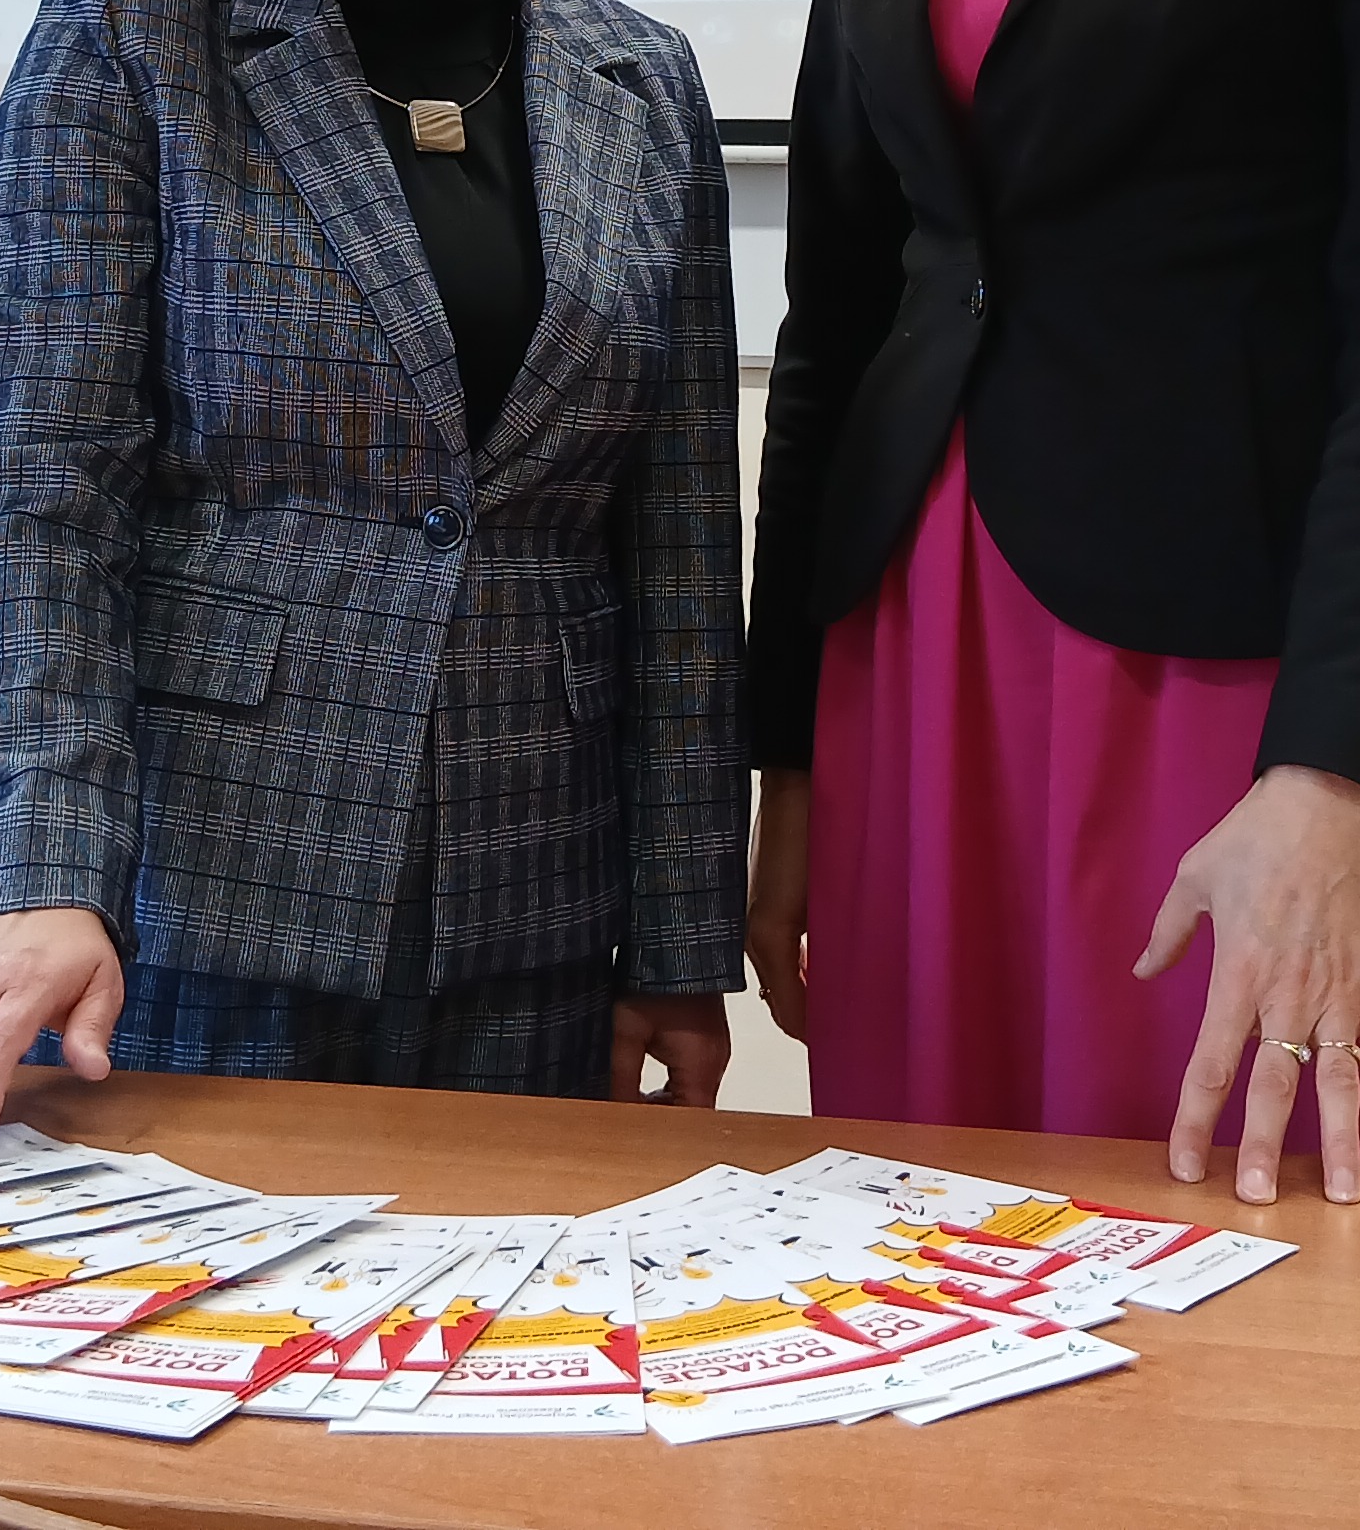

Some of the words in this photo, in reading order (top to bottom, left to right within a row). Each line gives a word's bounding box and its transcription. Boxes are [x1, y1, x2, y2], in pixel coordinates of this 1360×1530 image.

[1084, 1227, 1160, 1263] DOTAC
[769, 1338, 821, 1353] DLA
[70, 1348, 228, 1373] DOTACJ
[536, 1357, 589, 1367] DLA
[644, 1350, 766, 1374] MŁODYCH
[654, 1346, 837, 1385] DOTACJE
[443, 1366, 590, 1381] DOTAC
